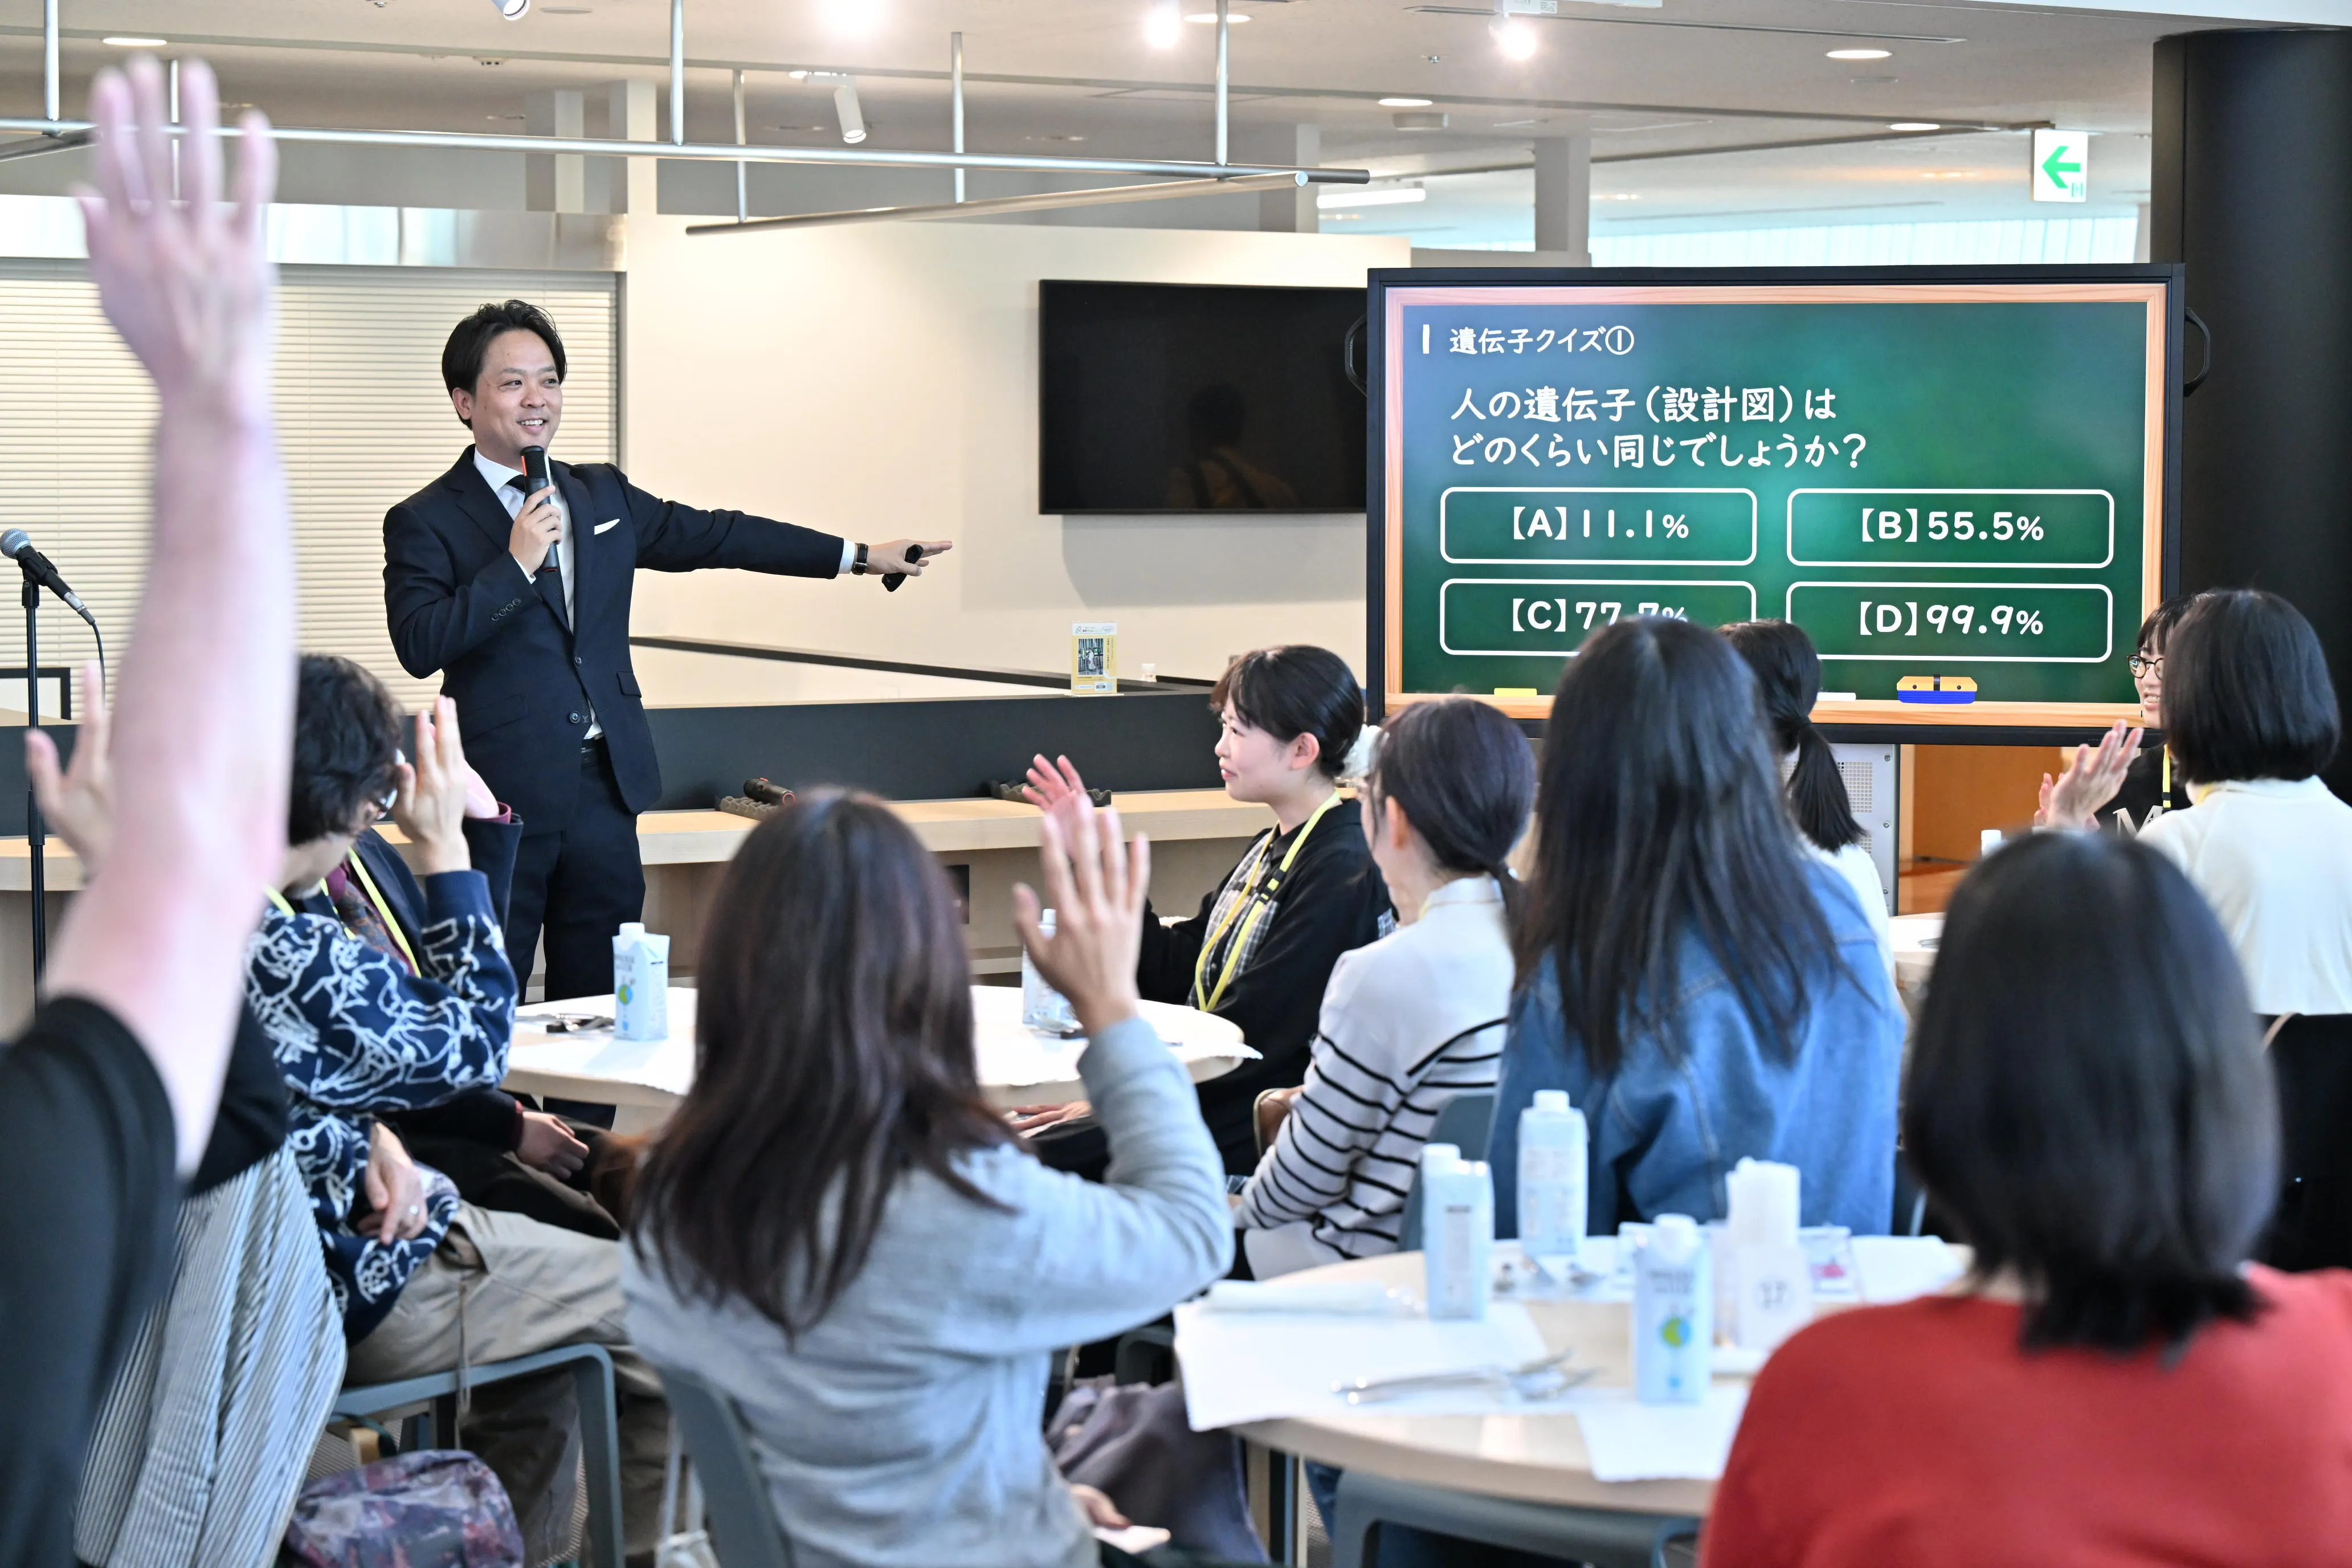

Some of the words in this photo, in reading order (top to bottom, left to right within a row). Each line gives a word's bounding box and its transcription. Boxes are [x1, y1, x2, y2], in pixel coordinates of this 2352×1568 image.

[1449, 325, 1635, 356] 遺伝子クイズ①
[1451, 385, 1837, 423] 人の遺伝子（設計図）は
[1452, 431, 1867, 468] どのくらい同じでしょうか？
